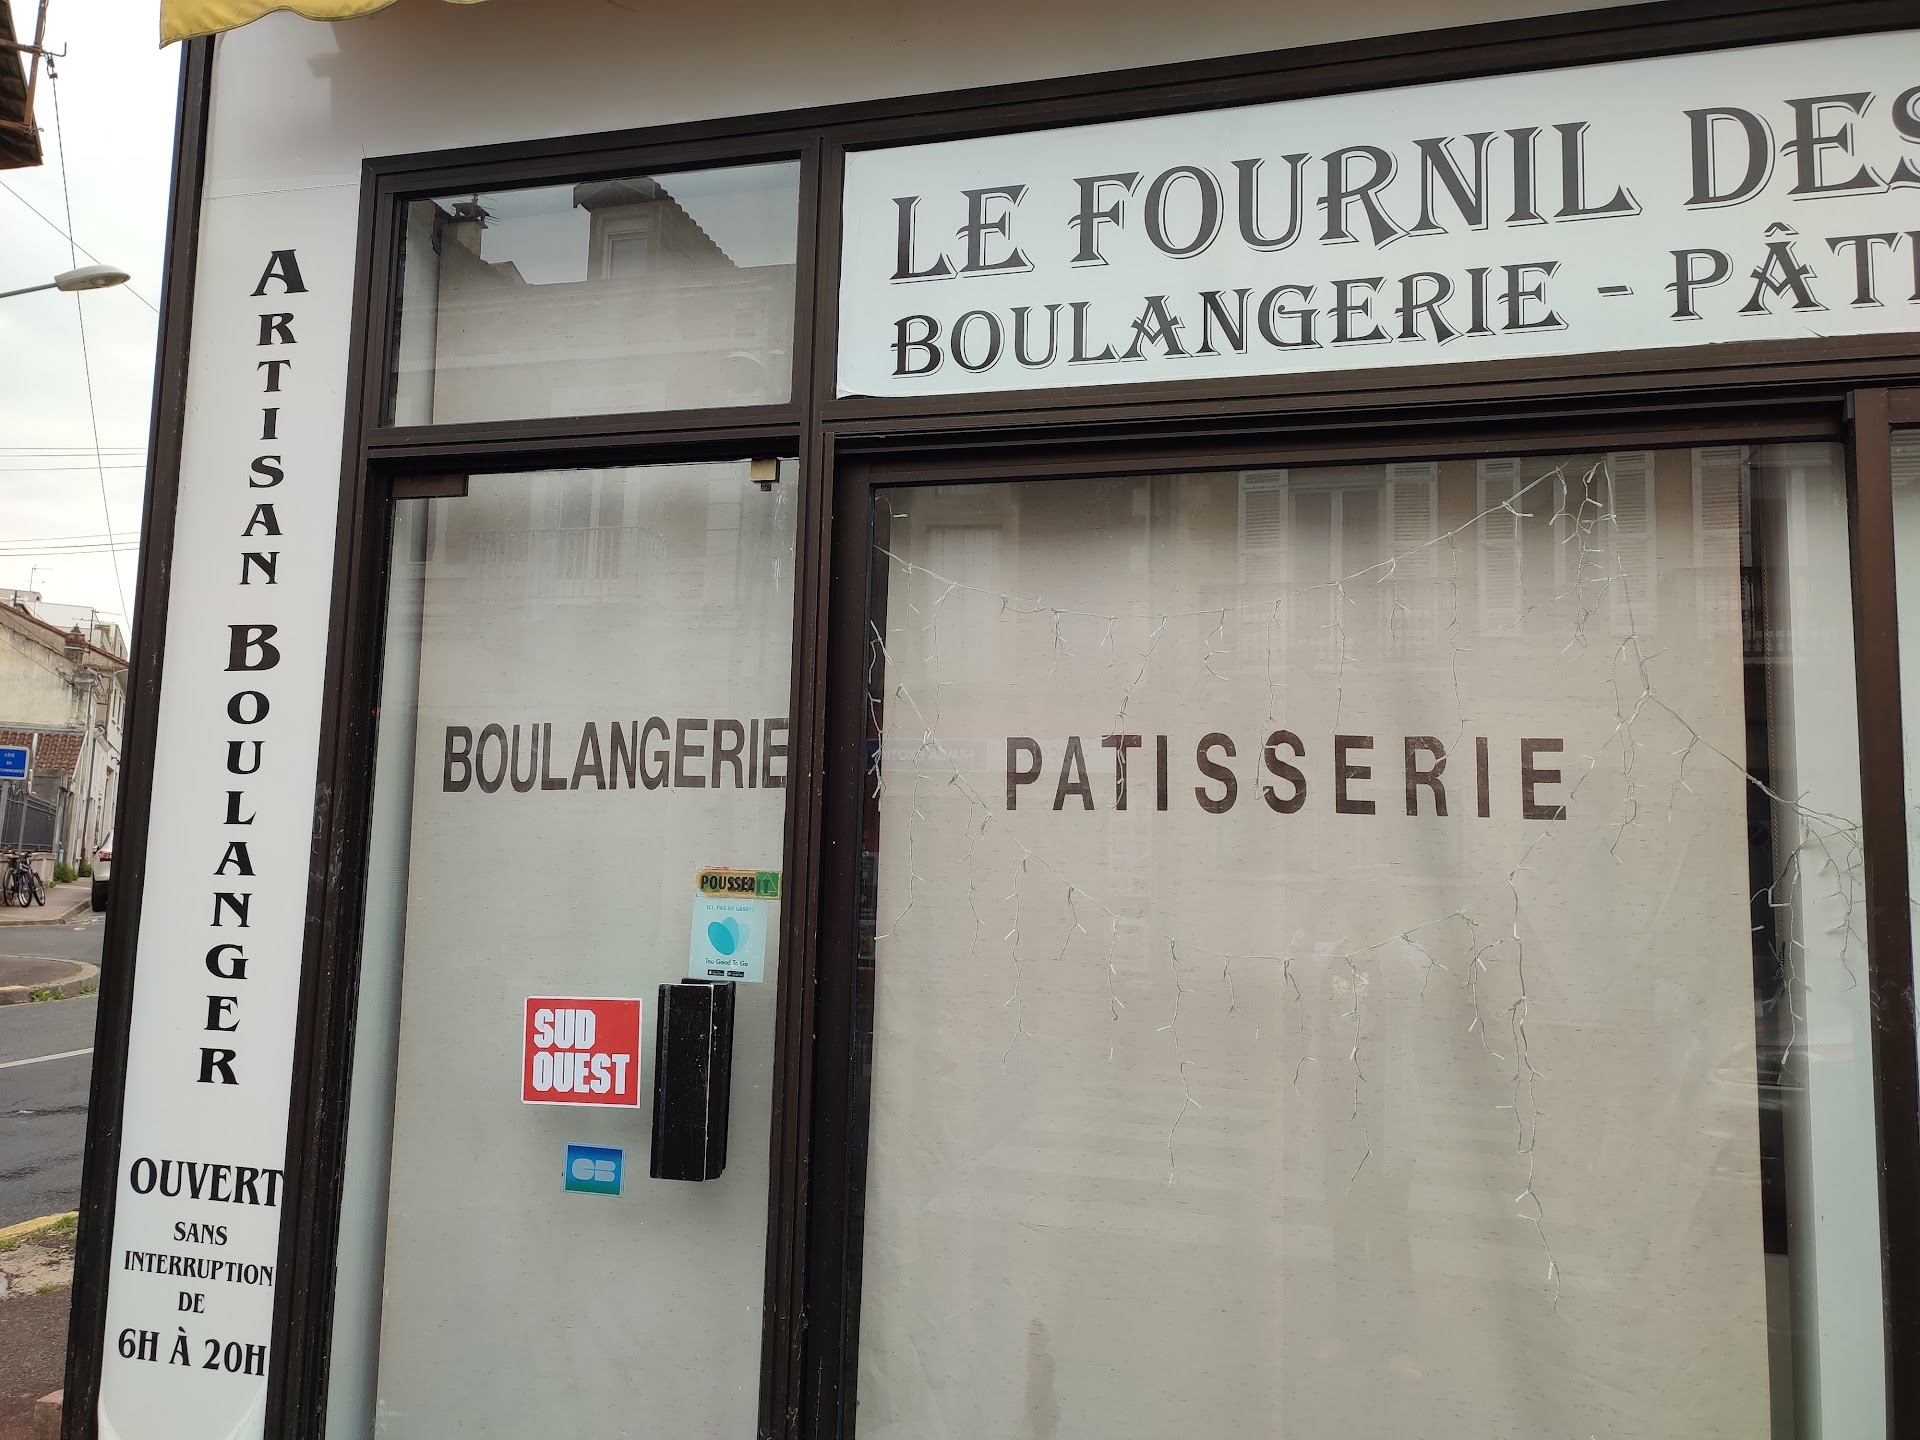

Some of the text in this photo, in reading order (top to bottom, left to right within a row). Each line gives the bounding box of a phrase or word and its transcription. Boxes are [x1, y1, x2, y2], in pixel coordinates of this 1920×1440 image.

[889, 184, 1035, 285] LE
[1068, 121, 1643, 269] FOURNIL
[891, 260, 1569, 380] BOULANGERIE
[196, 248, 309, 1086] ARTISAN BOULANGER
[443, 716, 789, 793] BOULANGERIE
[1005, 729, 1567, 820] PATISSERIE
[534, 1008, 596, 1049] SUD
[532, 1052, 630, 1095] OUEST
[130, 1157, 284, 1207] OUVERT
[572, 1158, 616, 1182] CB
[173, 1221, 228, 1245] SANS
[124, 1250, 274, 1286] INTERRUPTION
[177, 1291, 205, 1314] DE
[118, 1326, 267, 1377] 6H À 20H
